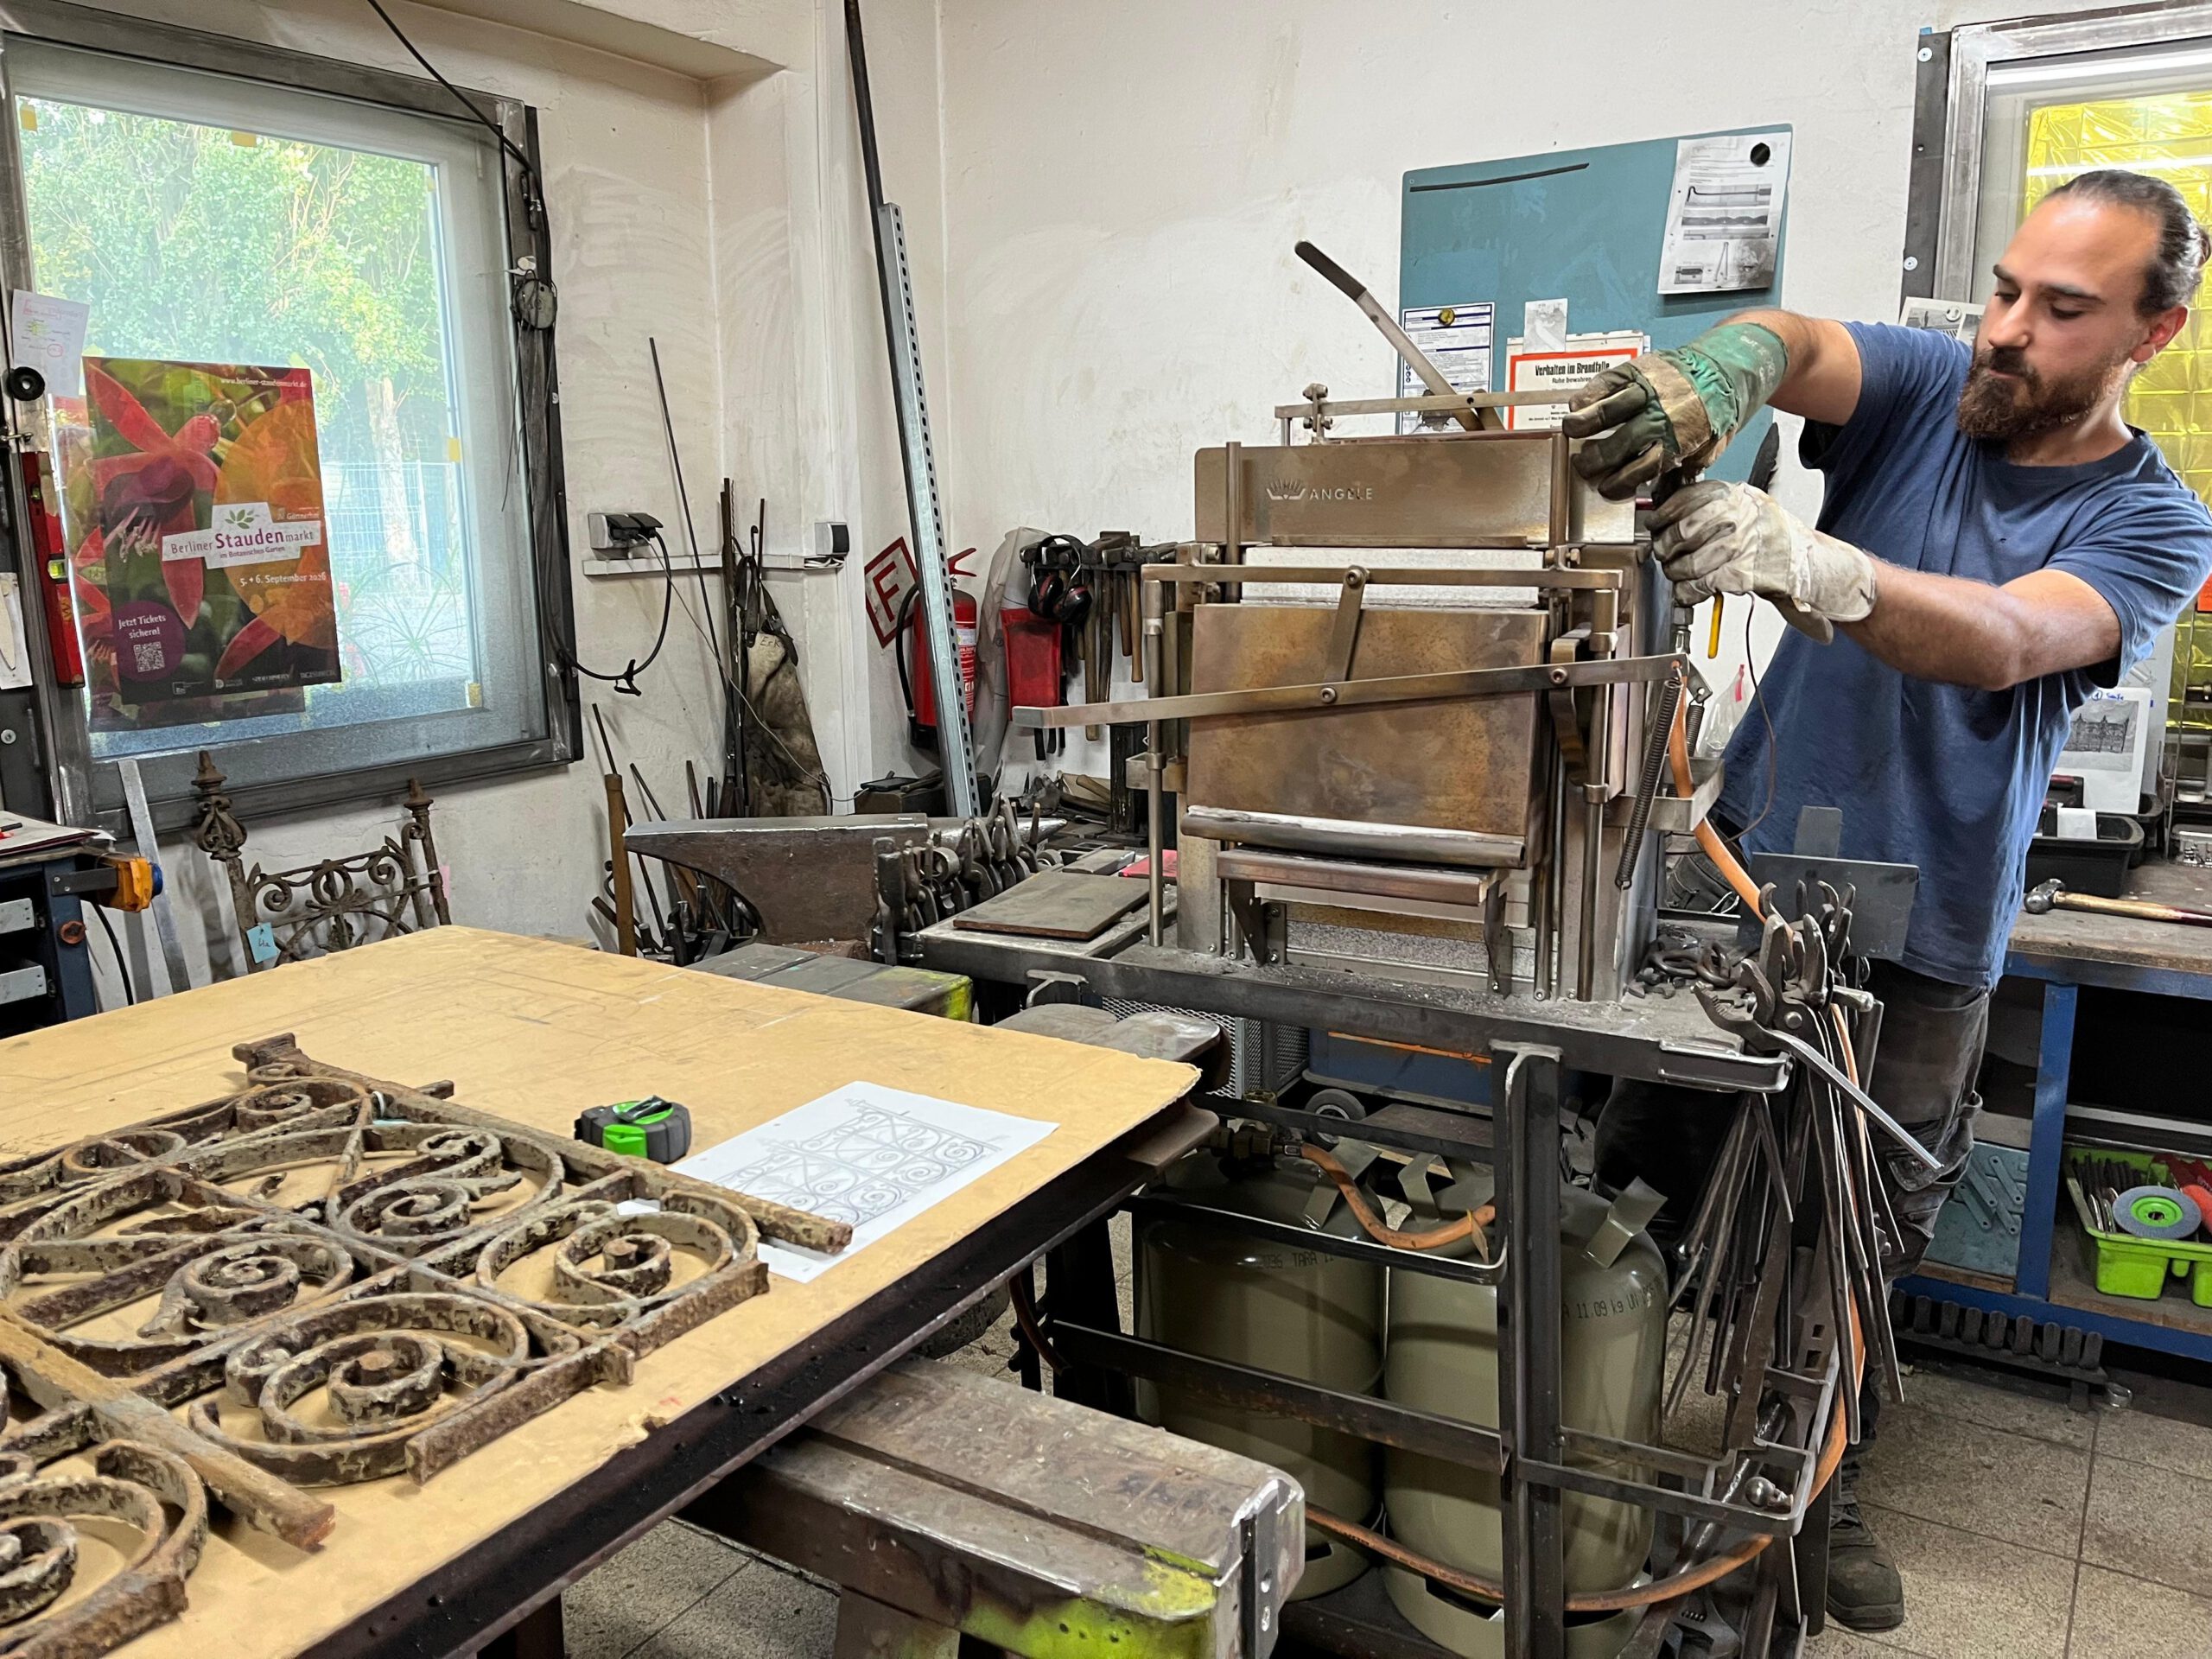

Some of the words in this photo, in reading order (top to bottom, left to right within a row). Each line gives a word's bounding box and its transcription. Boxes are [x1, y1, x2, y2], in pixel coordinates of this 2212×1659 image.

[1535, 364, 1566, 376] Verhalten
[1567, 363, 1575, 374] im
[1310, 487, 1372, 500] ANGELE
[171, 540, 213, 554] Berliner
[229, 548, 264, 557] Botanischen
[265, 573, 307, 584] September
[873, 561, 899, 622] F
[118, 618, 137, 630] Jetzt
[137, 614, 167, 625] Tickets
[129, 626, 161, 639] sichern!
[1292, 1251, 1318, 1267] TARA
[1577, 1300, 1608, 1319] 11.09
[1610, 1298, 1624, 1313] kg
